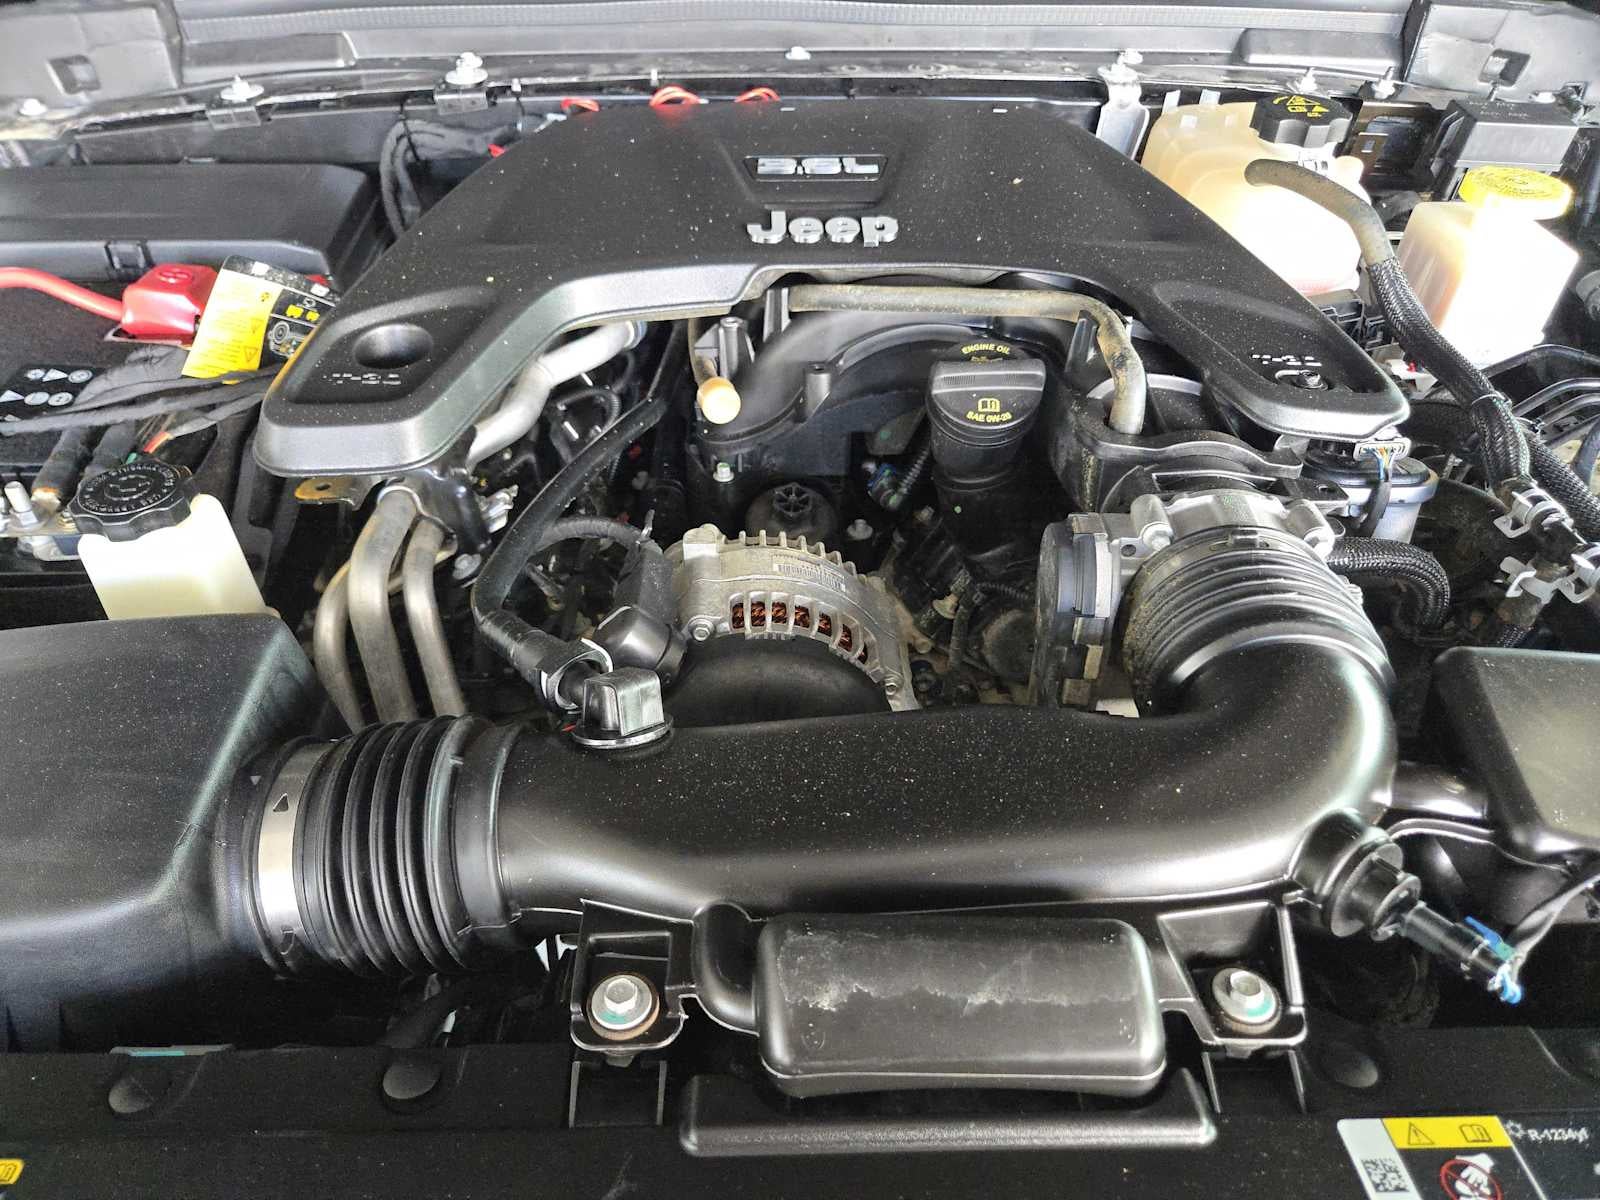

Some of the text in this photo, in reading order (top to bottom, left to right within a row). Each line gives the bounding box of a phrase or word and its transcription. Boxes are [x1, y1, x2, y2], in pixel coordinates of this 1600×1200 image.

[746, 210, 899, 248] Jeep
[961, 343, 1011, 355] ENGINE OIL
[966, 411, 1012, 423] SAE 0W-20
